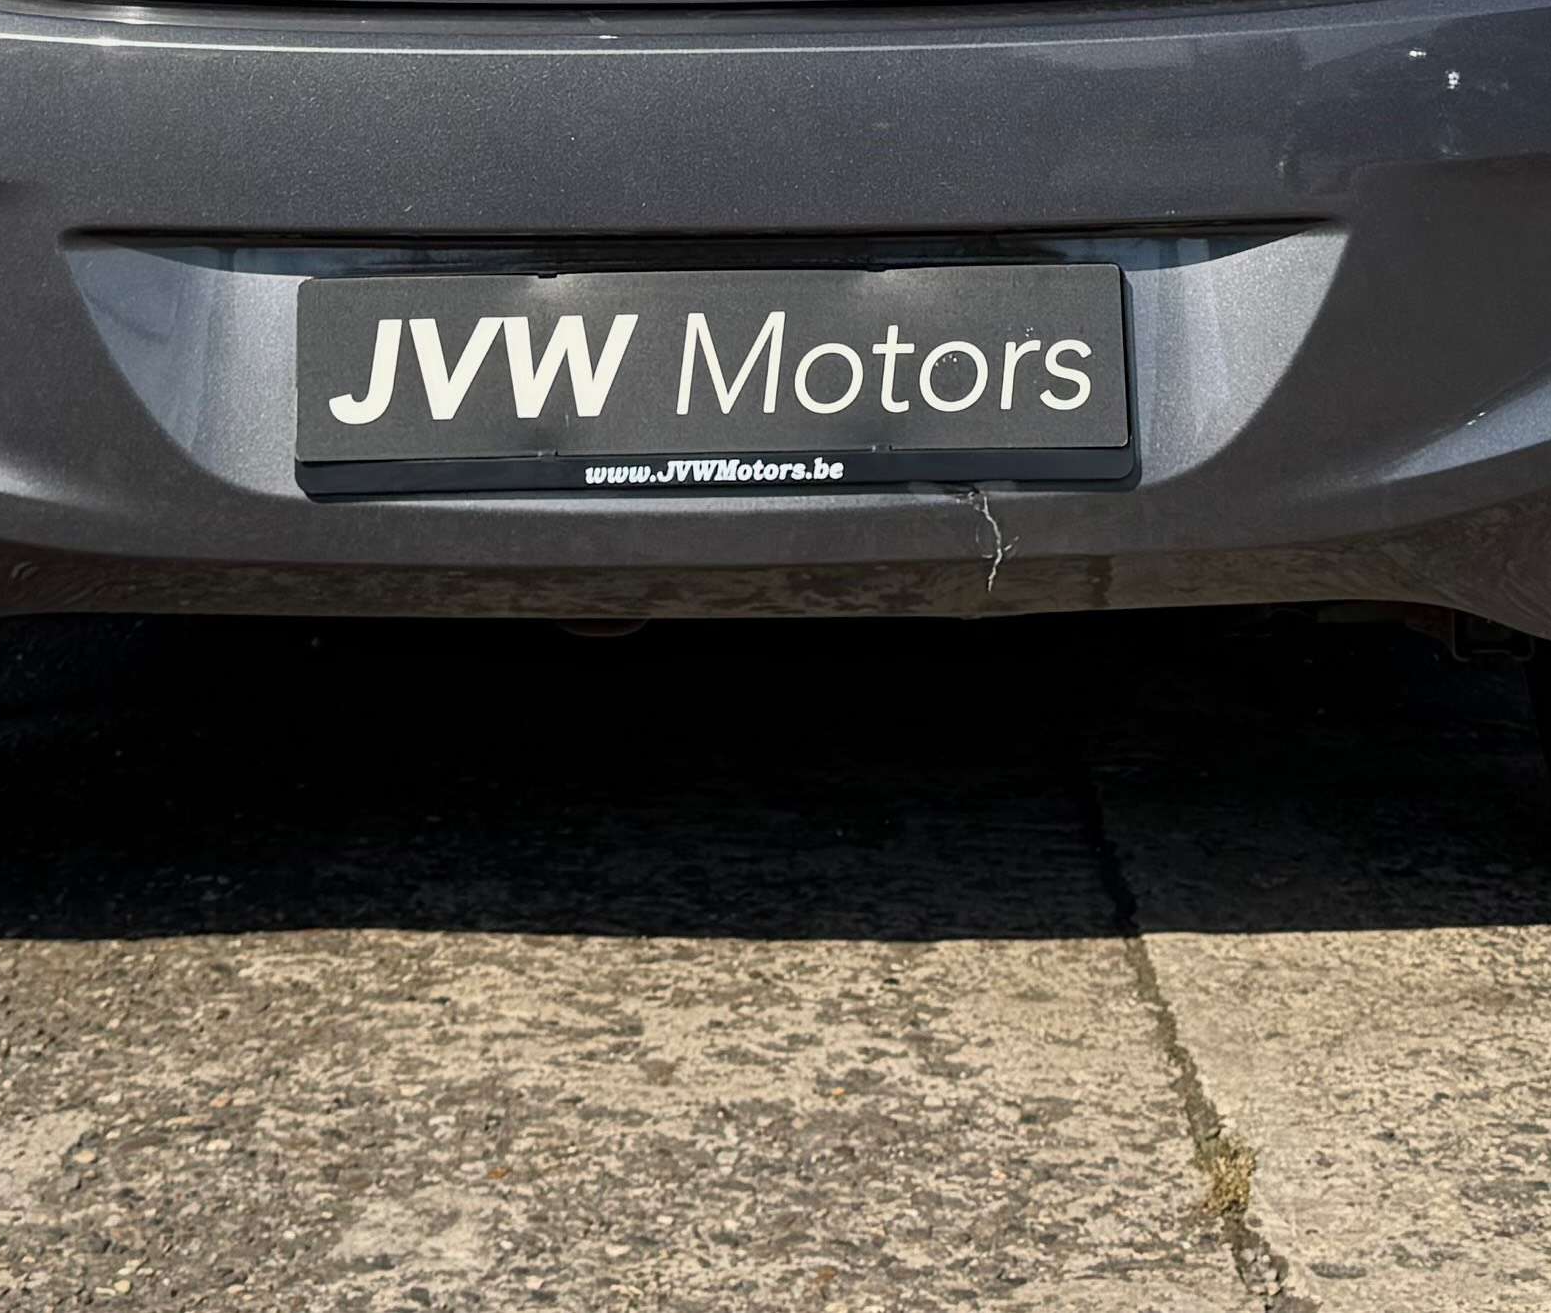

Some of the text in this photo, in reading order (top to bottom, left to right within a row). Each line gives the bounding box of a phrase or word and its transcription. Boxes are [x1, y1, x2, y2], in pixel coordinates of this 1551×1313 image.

[328, 311, 1093, 425] JVW Motors
[584, 457, 844, 484] www.JVWMotors.be
